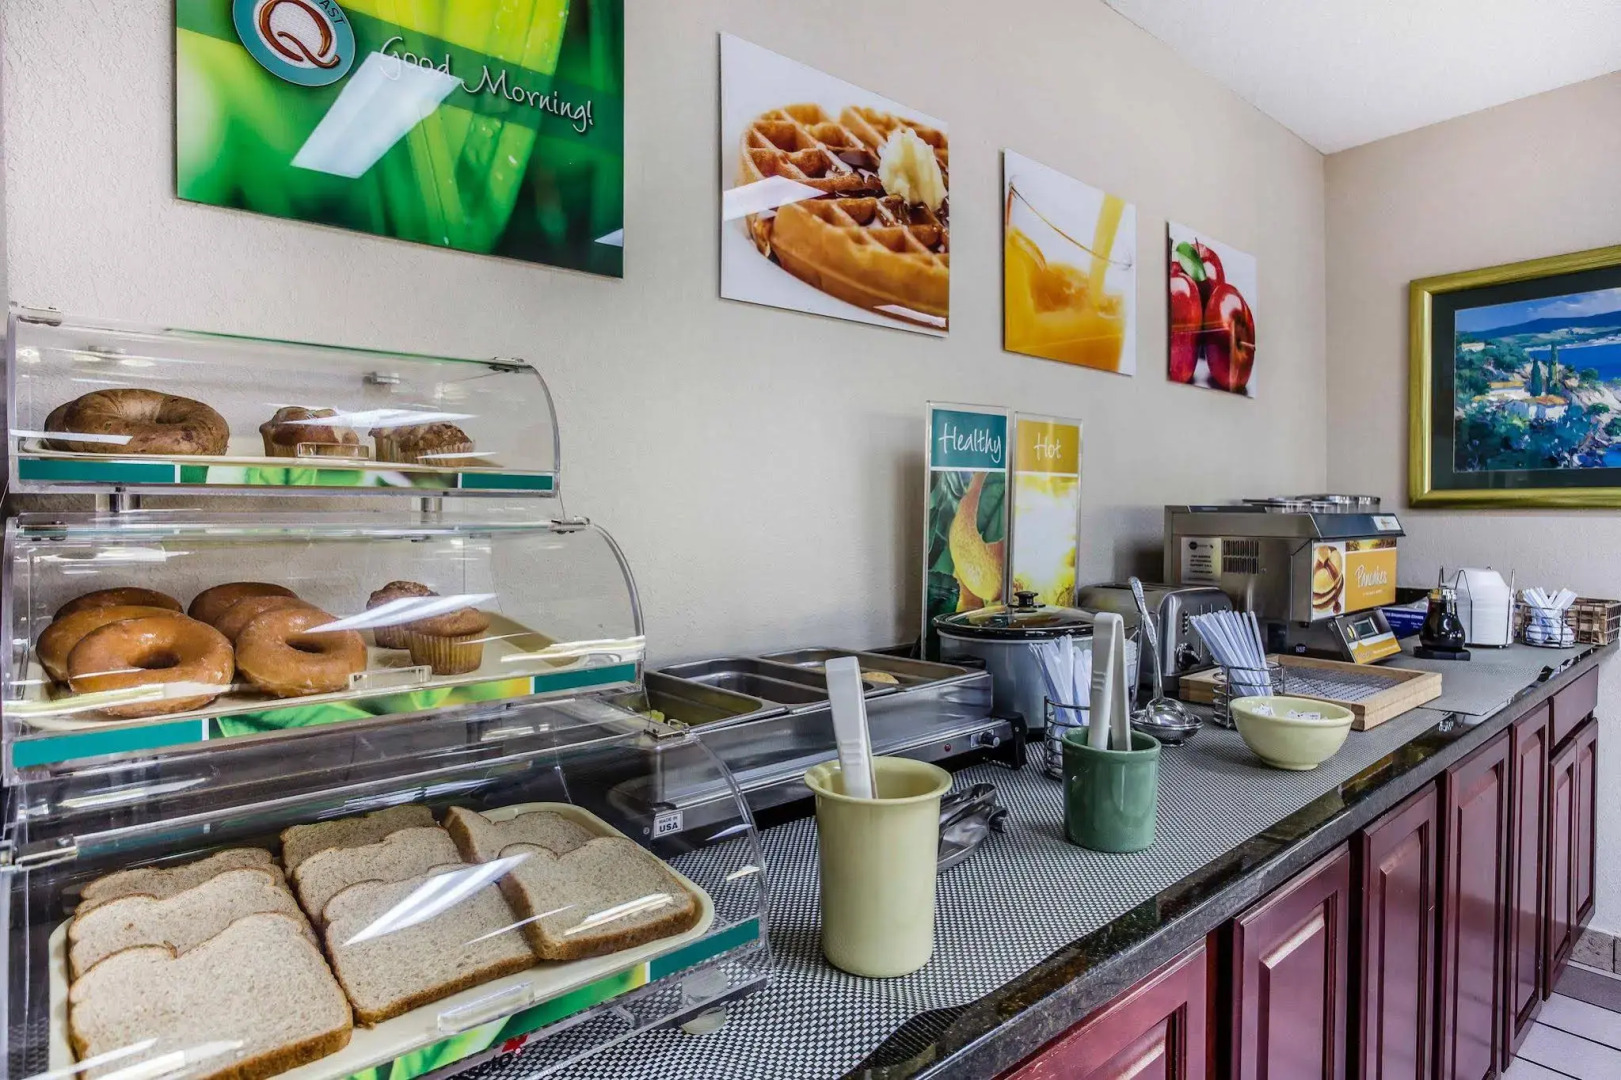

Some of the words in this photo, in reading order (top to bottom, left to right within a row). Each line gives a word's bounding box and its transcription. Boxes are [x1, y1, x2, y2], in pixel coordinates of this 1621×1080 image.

[379, 36, 453, 81] Good
[461, 65, 594, 133] Morning!
[938, 422, 1002, 464] Healthy
[1033, 432, 1062, 461] Hot
[1354, 564, 1388, 588] Pancakes
[660, 822, 678, 832] USA
